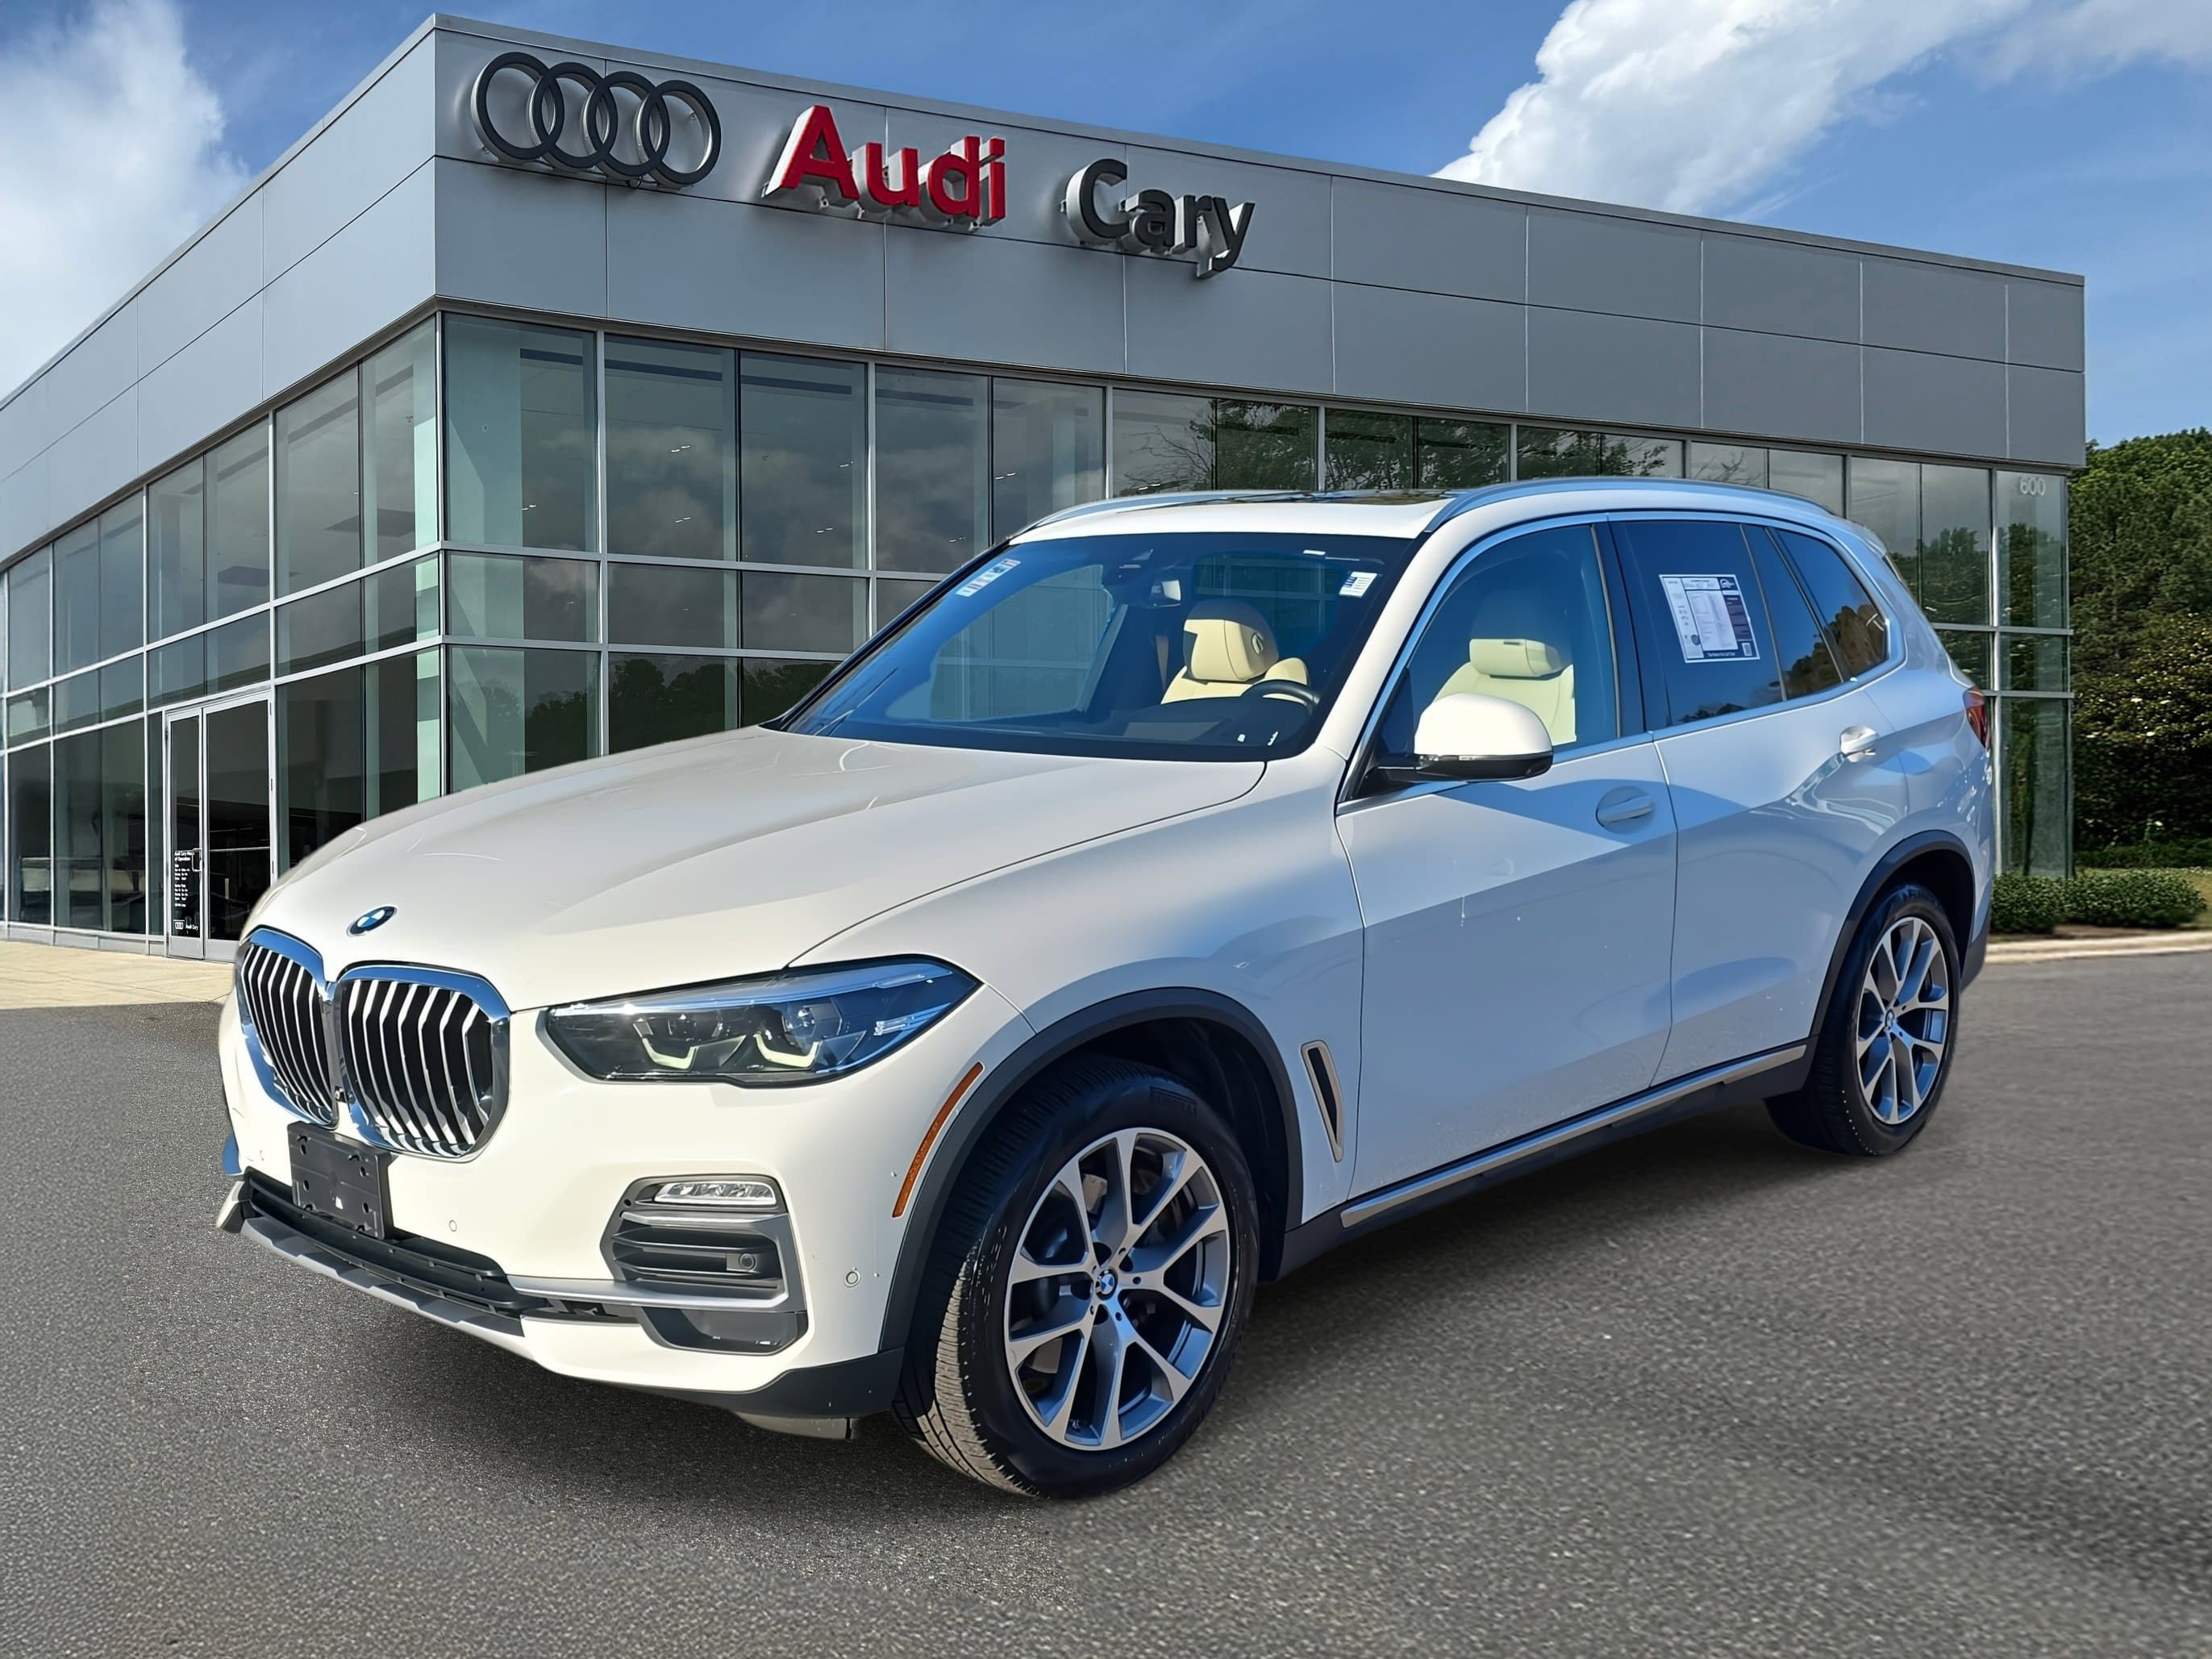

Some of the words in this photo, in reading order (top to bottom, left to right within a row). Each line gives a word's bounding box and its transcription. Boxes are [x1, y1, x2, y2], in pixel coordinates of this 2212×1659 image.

[776, 105, 1006, 220] Audi
[1076, 158, 1256, 273] Cary
[2020, 477, 2046, 496] 600
